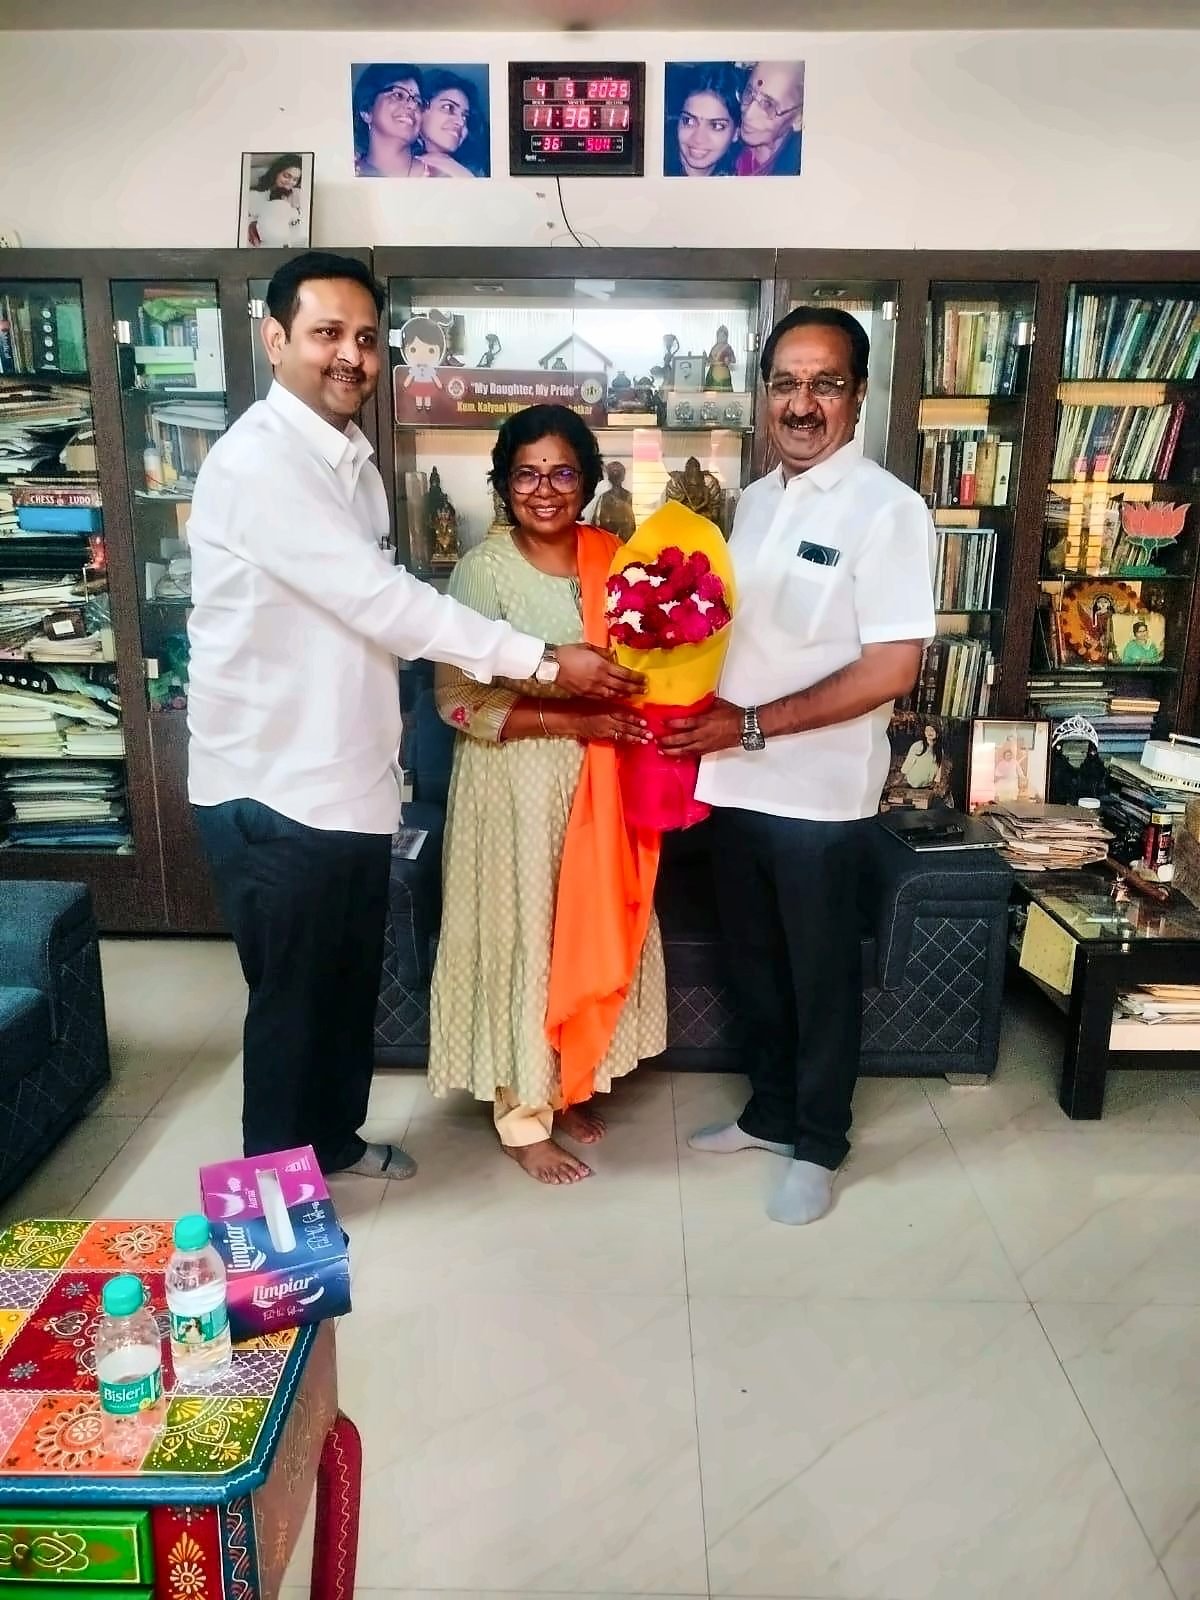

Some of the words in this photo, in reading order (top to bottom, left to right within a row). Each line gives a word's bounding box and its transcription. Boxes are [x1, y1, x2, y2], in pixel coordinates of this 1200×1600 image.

[536, 82, 545, 97] 4
[565, 82, 575, 97] 5
[588, 82, 628, 98] 2025
[542, 137, 560, 151] 36
[489, 383, 534, 396] Daughter,
[535, 384, 549, 396] My
[30, 495, 55, 504] CHESS
[69, 495, 91, 504] LUDO
[252, 1276, 314, 1307] Limpiar
